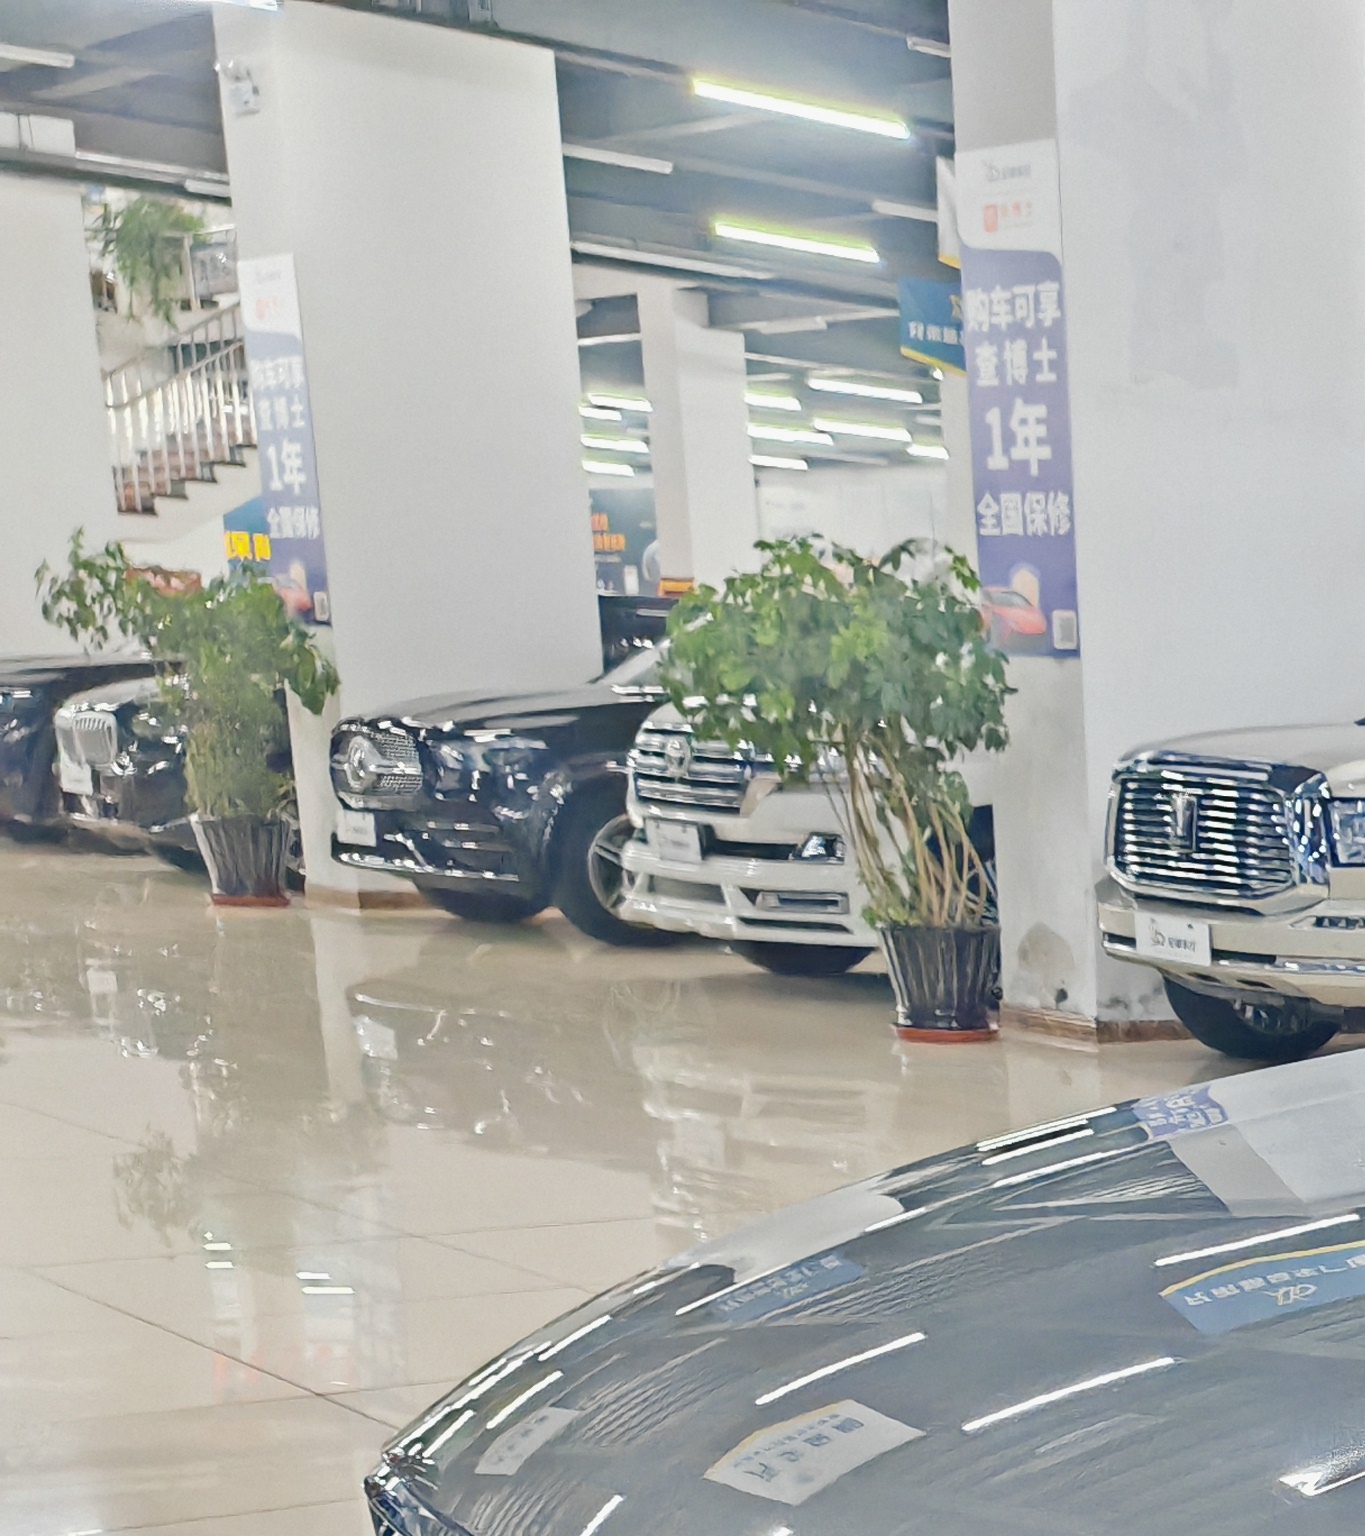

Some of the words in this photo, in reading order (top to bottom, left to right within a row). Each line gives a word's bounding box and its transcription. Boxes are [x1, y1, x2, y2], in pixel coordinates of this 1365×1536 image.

[966, 280, 1062, 332] 购车可享
[975, 336, 1057, 387] 查博士
[986, 398, 1052, 477] 1年
[977, 490, 1071, 537] 全国保修
